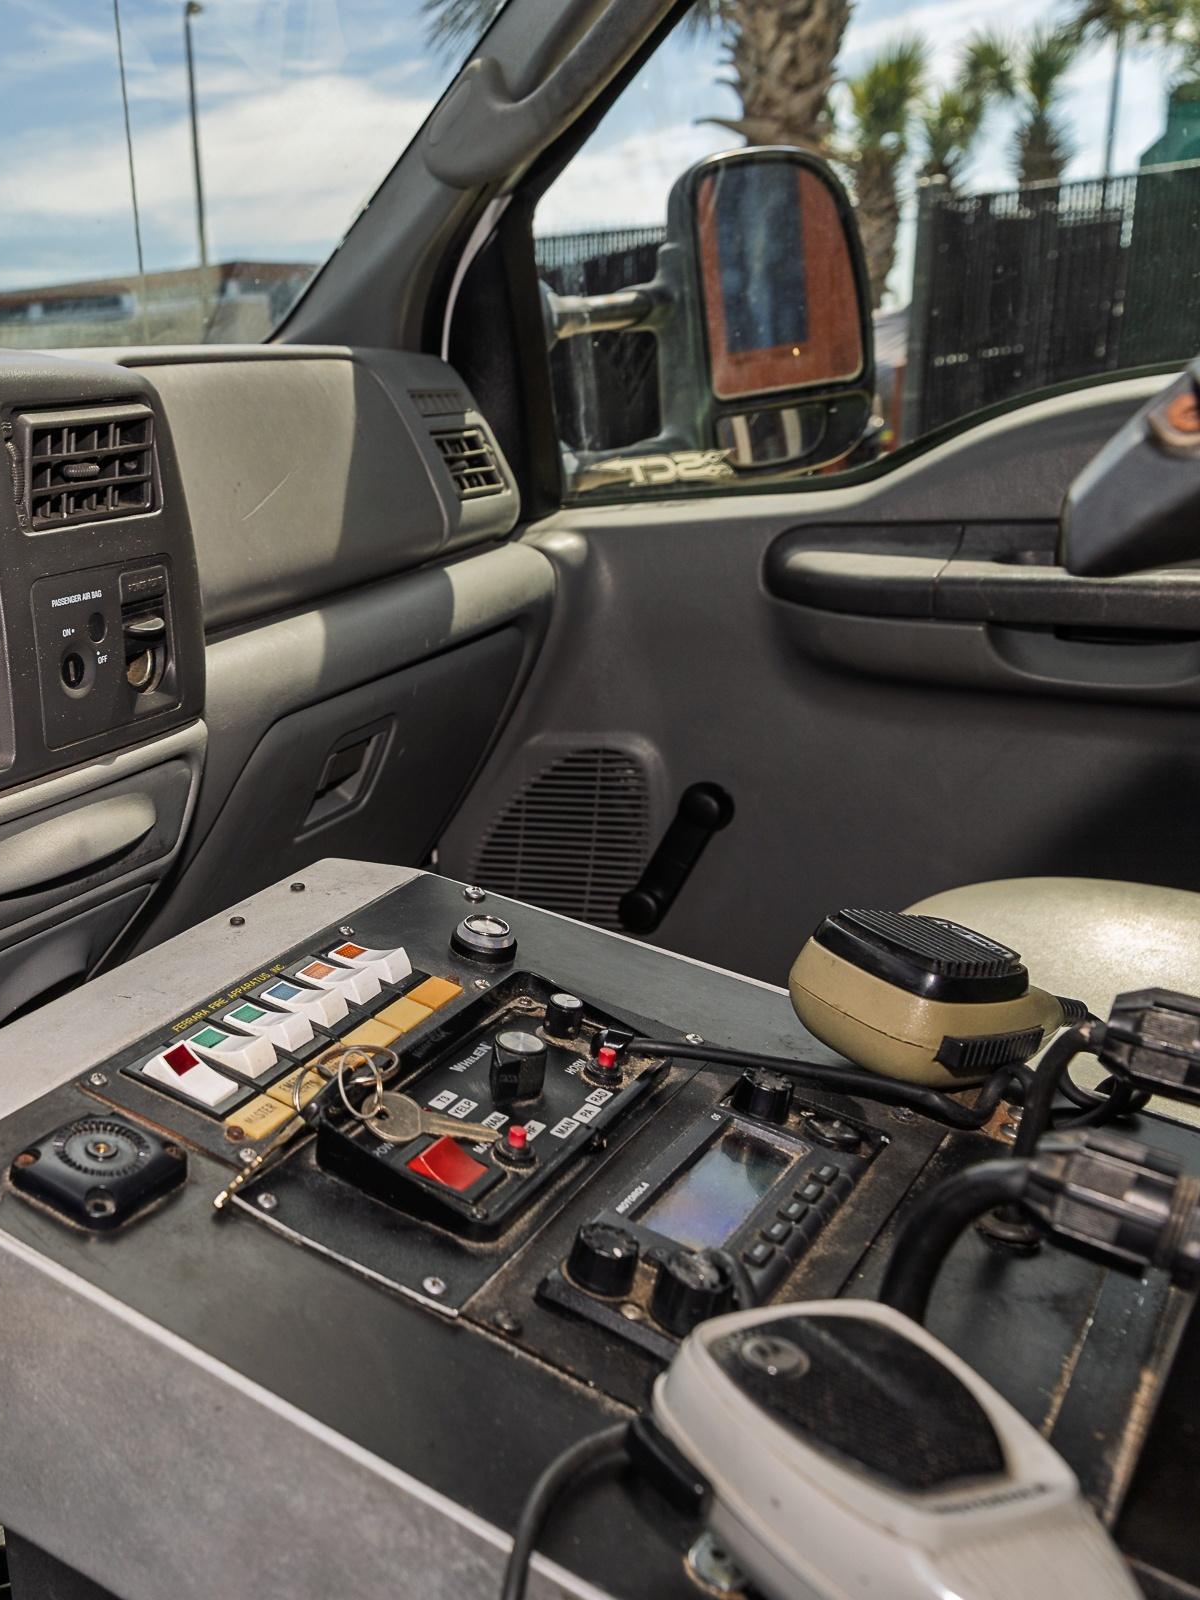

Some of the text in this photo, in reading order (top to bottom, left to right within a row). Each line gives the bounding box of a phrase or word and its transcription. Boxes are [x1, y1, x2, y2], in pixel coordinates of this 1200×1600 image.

[52, 590, 103, 608] PASSENGER AIR BAG
[62, 629, 72, 638] ON
[97, 655, 108, 665] OFF
[172, 1009, 209, 1032] FERRARA
[208, 997, 228, 1011] FIRE
[449, 1042, 492, 1073] WHELEN
[564, 1058, 587, 1075] HORN
[452, 1101, 474, 1119] YELP
[580, 1108, 594, 1119] PA
[556, 1120, 575, 1135] MAN
[615, 1181, 650, 1215] MOTOROLA
